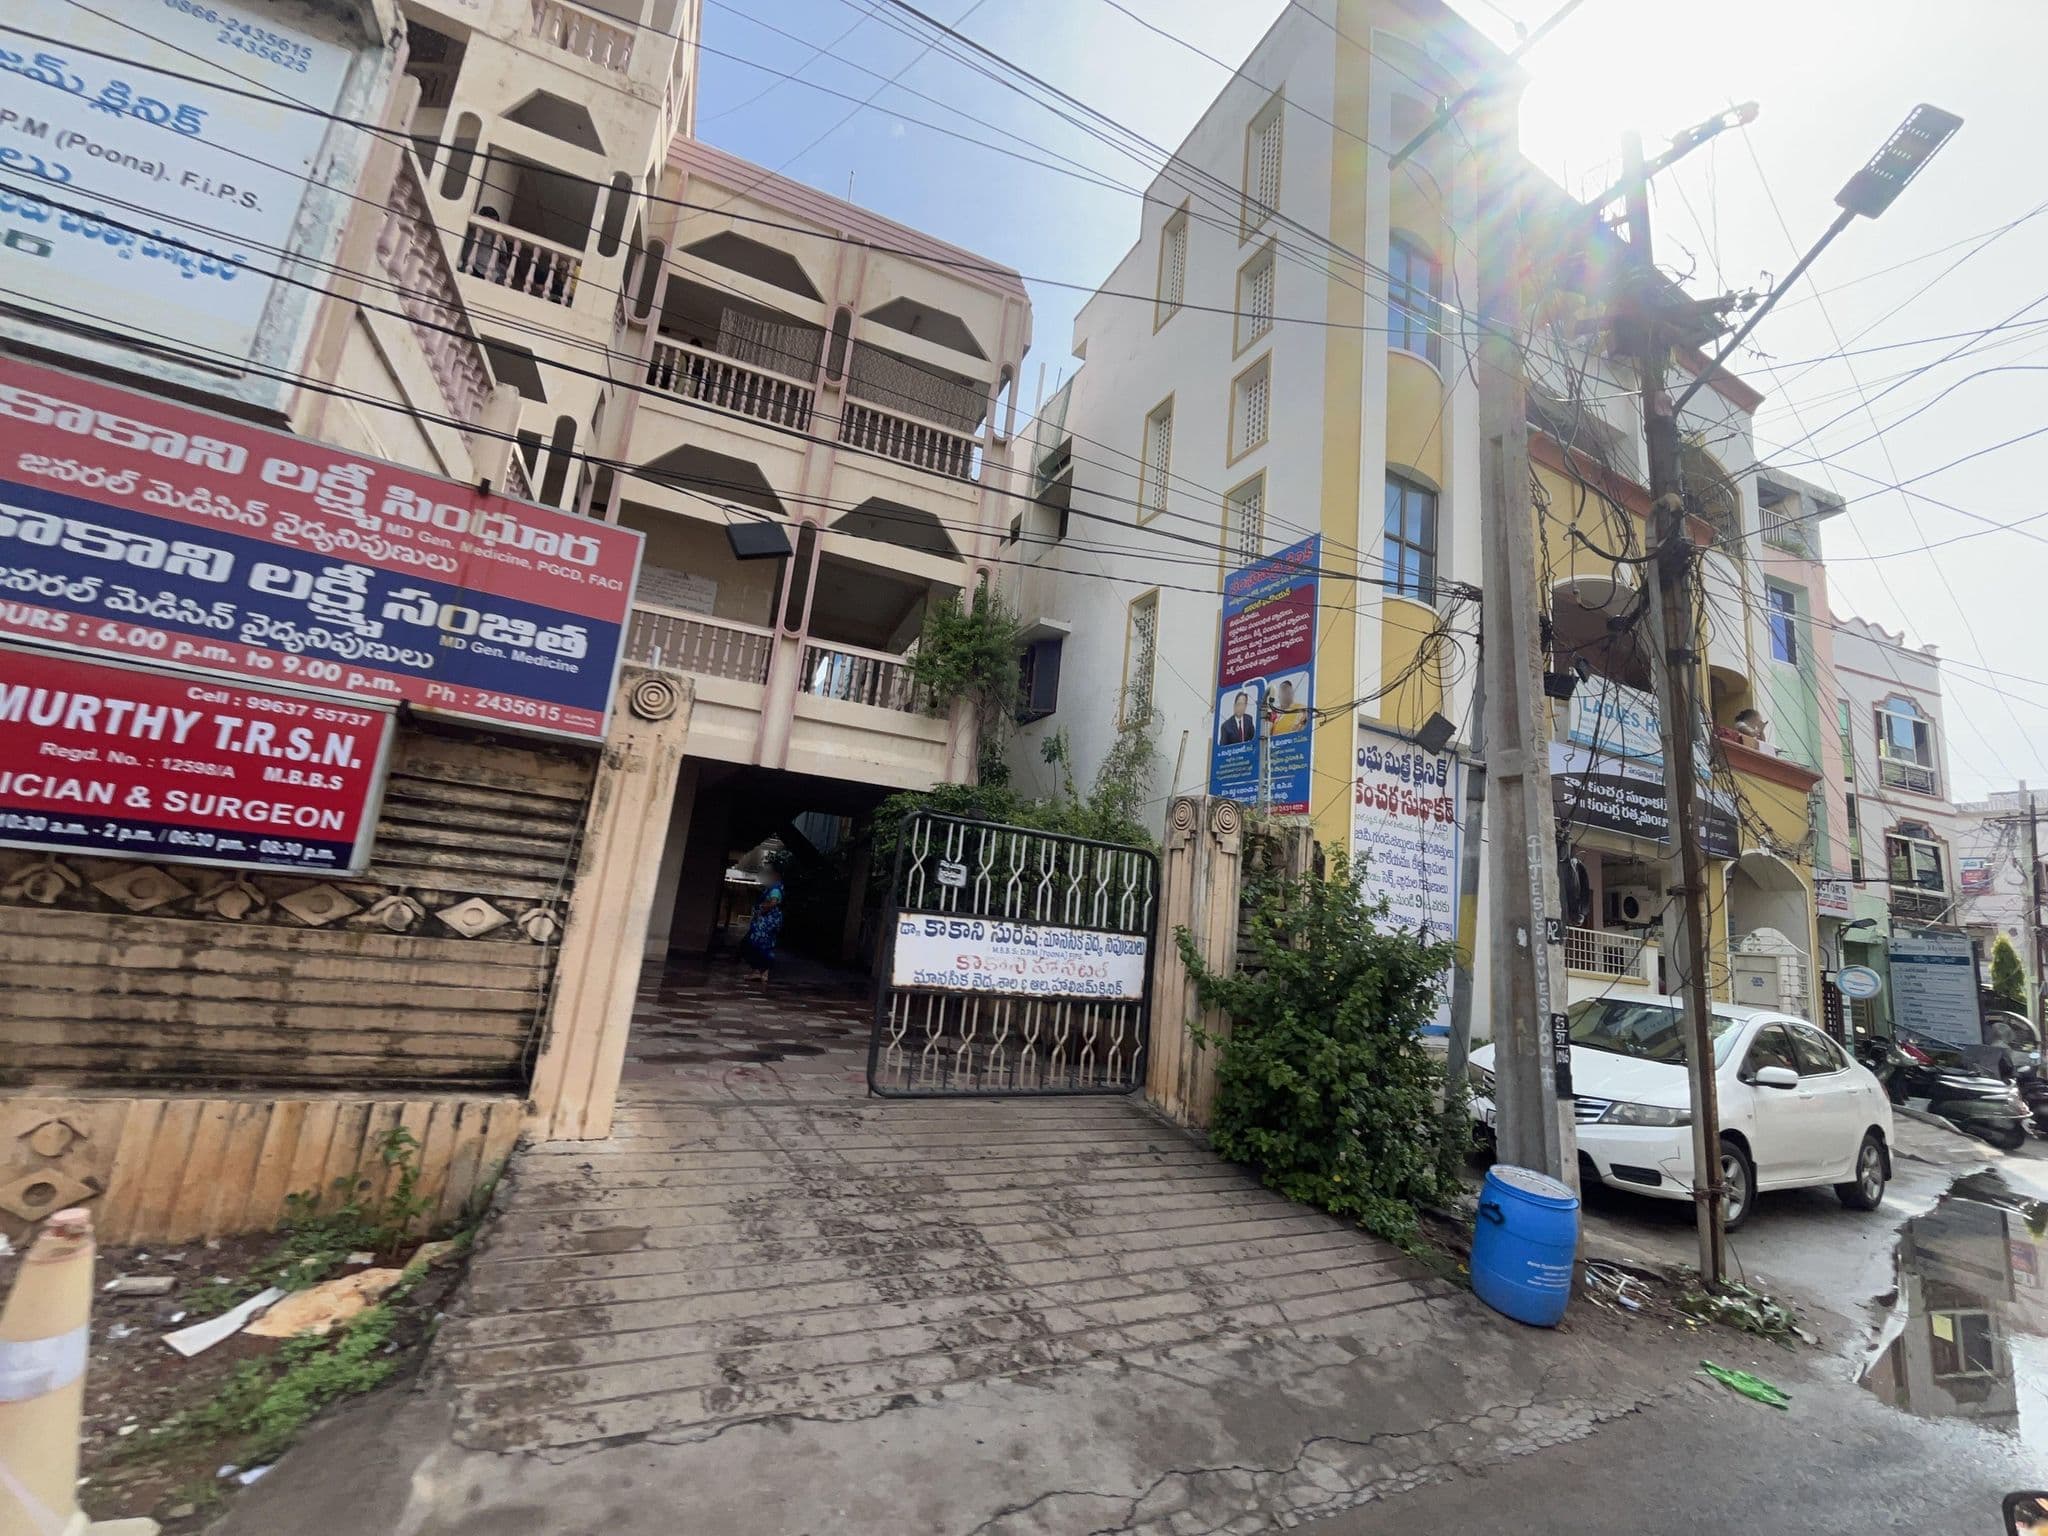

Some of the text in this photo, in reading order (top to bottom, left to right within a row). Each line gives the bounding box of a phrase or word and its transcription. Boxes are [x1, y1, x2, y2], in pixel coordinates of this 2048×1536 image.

[217, 30, 309, 74] 2435625
[16, 452, 141, 497] జనరల్
[142, 479, 270, 528] మెడిసిన్
[384, 521, 413, 540] MD
[416, 530, 456, 552] Gen.
[459, 540, 534, 573] Medicine,
[104, 581, 237, 632] మెడిసిన్
[97, 621, 169, 652] 6.00
[171, 638, 238, 665] p.m.
[245, 649, 274, 670] to
[281, 653, 343, 683] 9.00
[346, 671, 404, 695] p.m.
[424, 682, 457, 705] Ph
[474, 692, 561, 722] 2435615
[439, 634, 580, 676] MD Gen. Medicine
[0, 681, 364, 771] MURTHY T.R.S.N.
[186, 685, 229, 706] Cell
[245, 695, 310, 718] 99637
[312, 705, 374, 728] 55737
[1582, 695, 1660, 733] LADIES H
[39, 740, 103, 764] Regd.
[106, 749, 143, 769] No.
[262, 763, 345, 792] M.B.B.S
[124, 783, 153, 810] &
[162, 788, 346, 832] SURGEON
[103, 822, 117, 838] 2
[1415, 894, 1423, 908] 9
[924, 918, 985, 941] కాకాని
